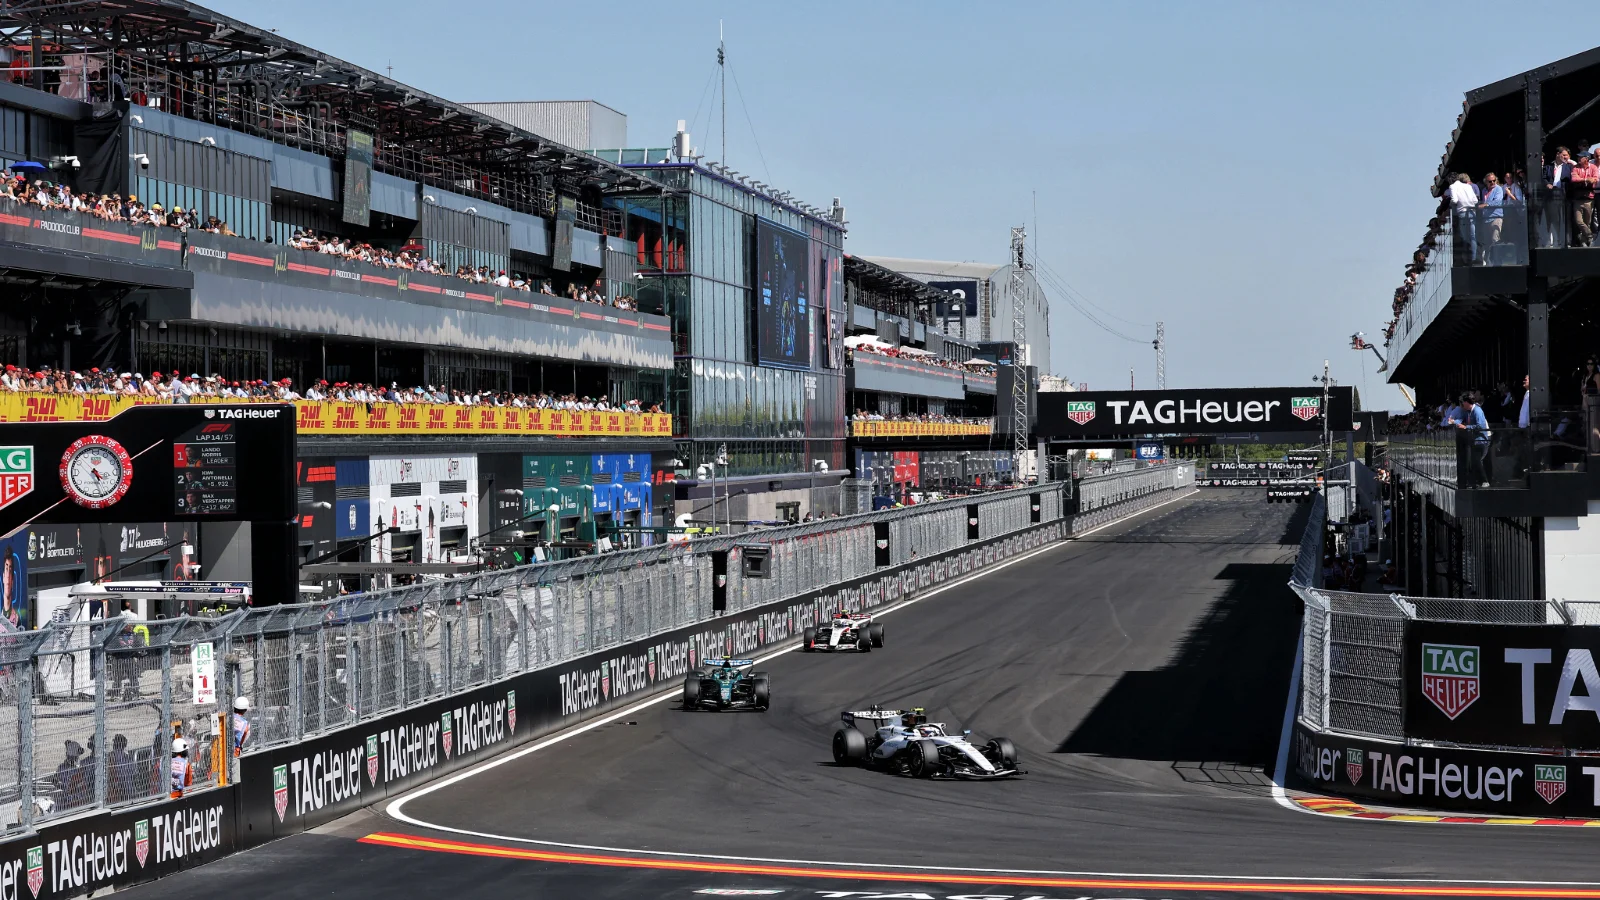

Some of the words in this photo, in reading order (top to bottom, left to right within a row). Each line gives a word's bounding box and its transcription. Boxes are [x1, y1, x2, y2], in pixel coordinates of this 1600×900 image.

[41, 221, 66, 233] PADDOCK
[66, 224, 80, 236] CLUB
[195, 246, 215, 258] PADDOCK
[216, 251, 226, 260] CLUB
[1070, 403, 1093, 411] TAG
[1294, 398, 1318, 406] TAG
[300, 405, 321, 428] DHL
[336, 406, 356, 428] DHL
[428, 408, 445, 428] DHL
[1069, 412, 1094, 423] HEUER
[178, 452, 184, 460] 1
[1141, 446, 1157, 455] FIA
[178, 476, 184, 484] 2
[178, 498, 184, 507] 3
[40, 536, 45, 558] 5
[128, 529, 136, 548] 27
[47, 547, 74, 558] BORTOLETO
[1426, 648, 1474, 674] TAG
[1425, 676, 1476, 714] HEUER
[454, 698, 506, 756] TAGHeuer
[380, 720, 440, 783] TAGHeuer
[1348, 751, 1362, 763] TAG
[291, 744, 364, 816] TAGHeuer
[1368, 751, 1524, 802] TAGHeuer
[1538, 767, 1562, 780] TAG
[1536, 782, 1564, 801] HEUER
[152, 805, 224, 864] TAGHeuer
[28, 850, 42, 868] TAG
[48, 829, 132, 894] TAGHeuer
